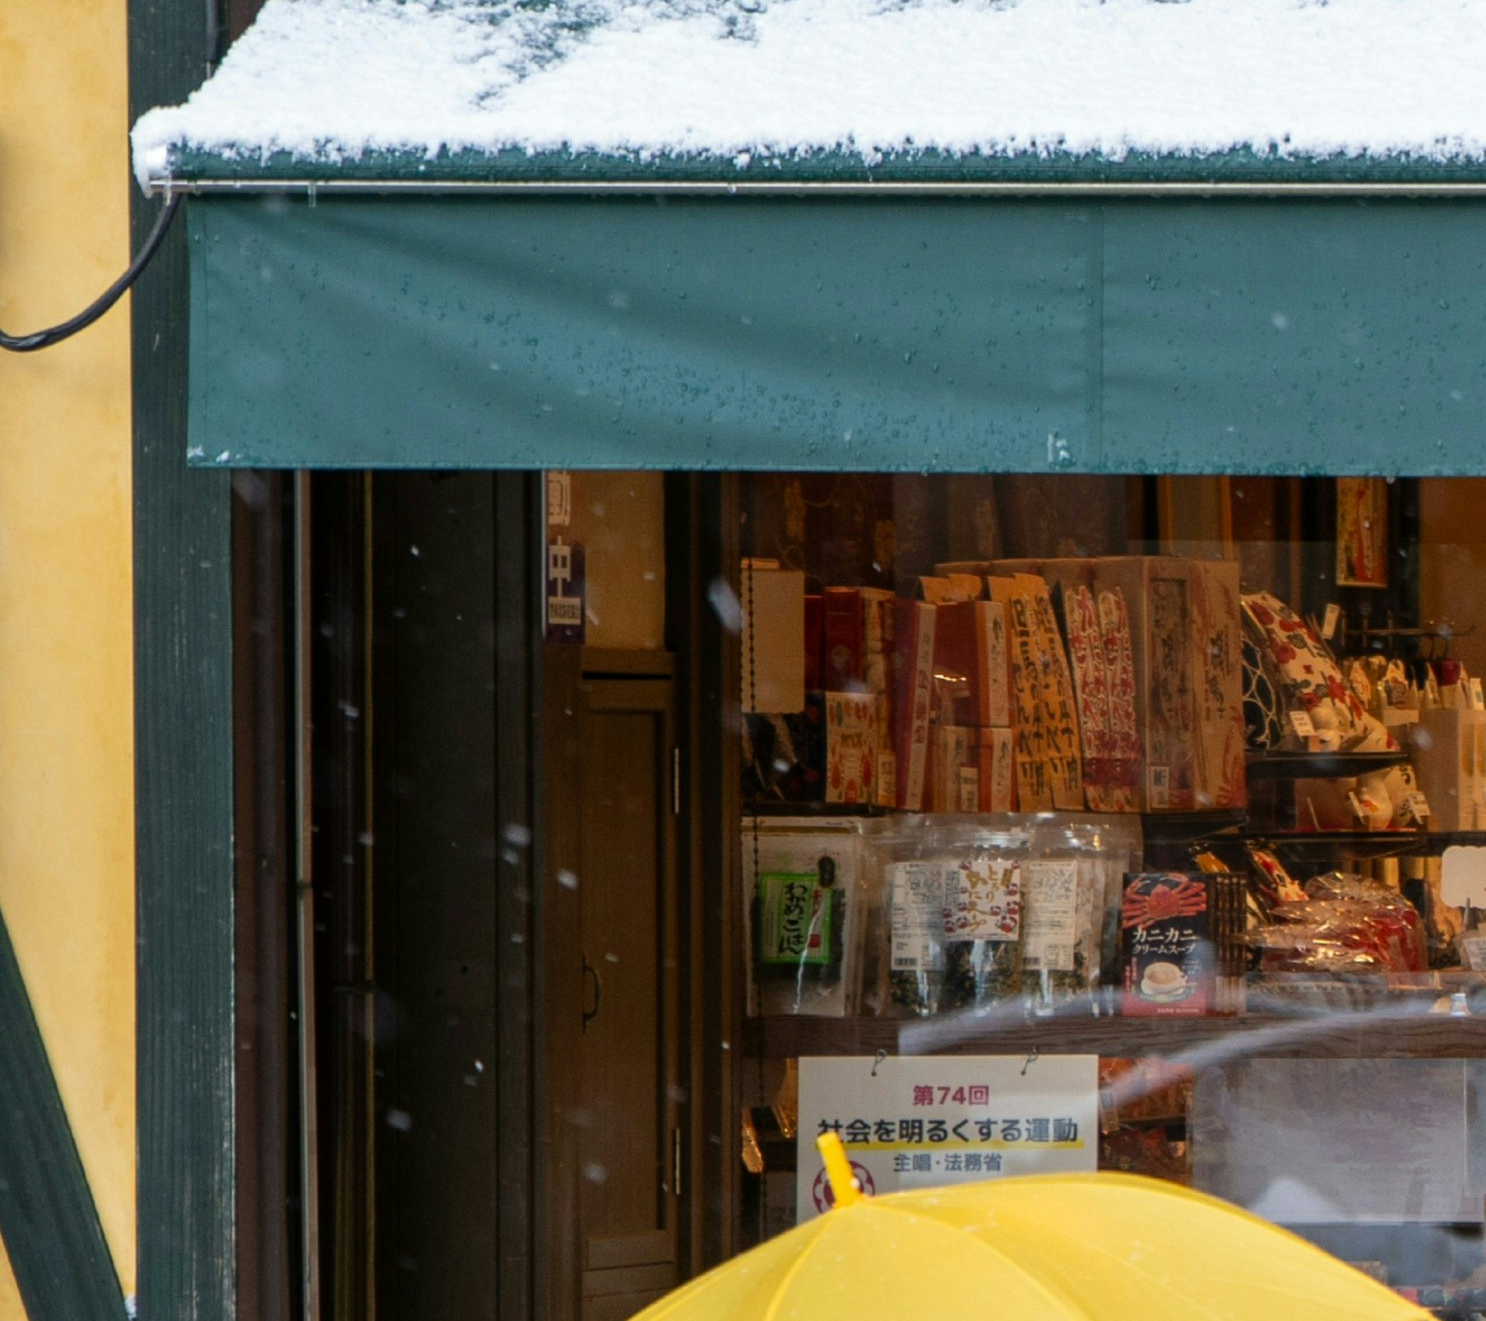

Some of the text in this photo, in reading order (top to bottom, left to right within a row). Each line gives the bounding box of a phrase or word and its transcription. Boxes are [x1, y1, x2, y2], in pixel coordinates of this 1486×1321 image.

[1131, 928, 1198, 944] カニカニ
[1133, 943, 1197, 955] クリームスープ
[912, 1084, 990, 1107] 第74回
[892, 1152, 1003, 1173] 主唱・法務省
